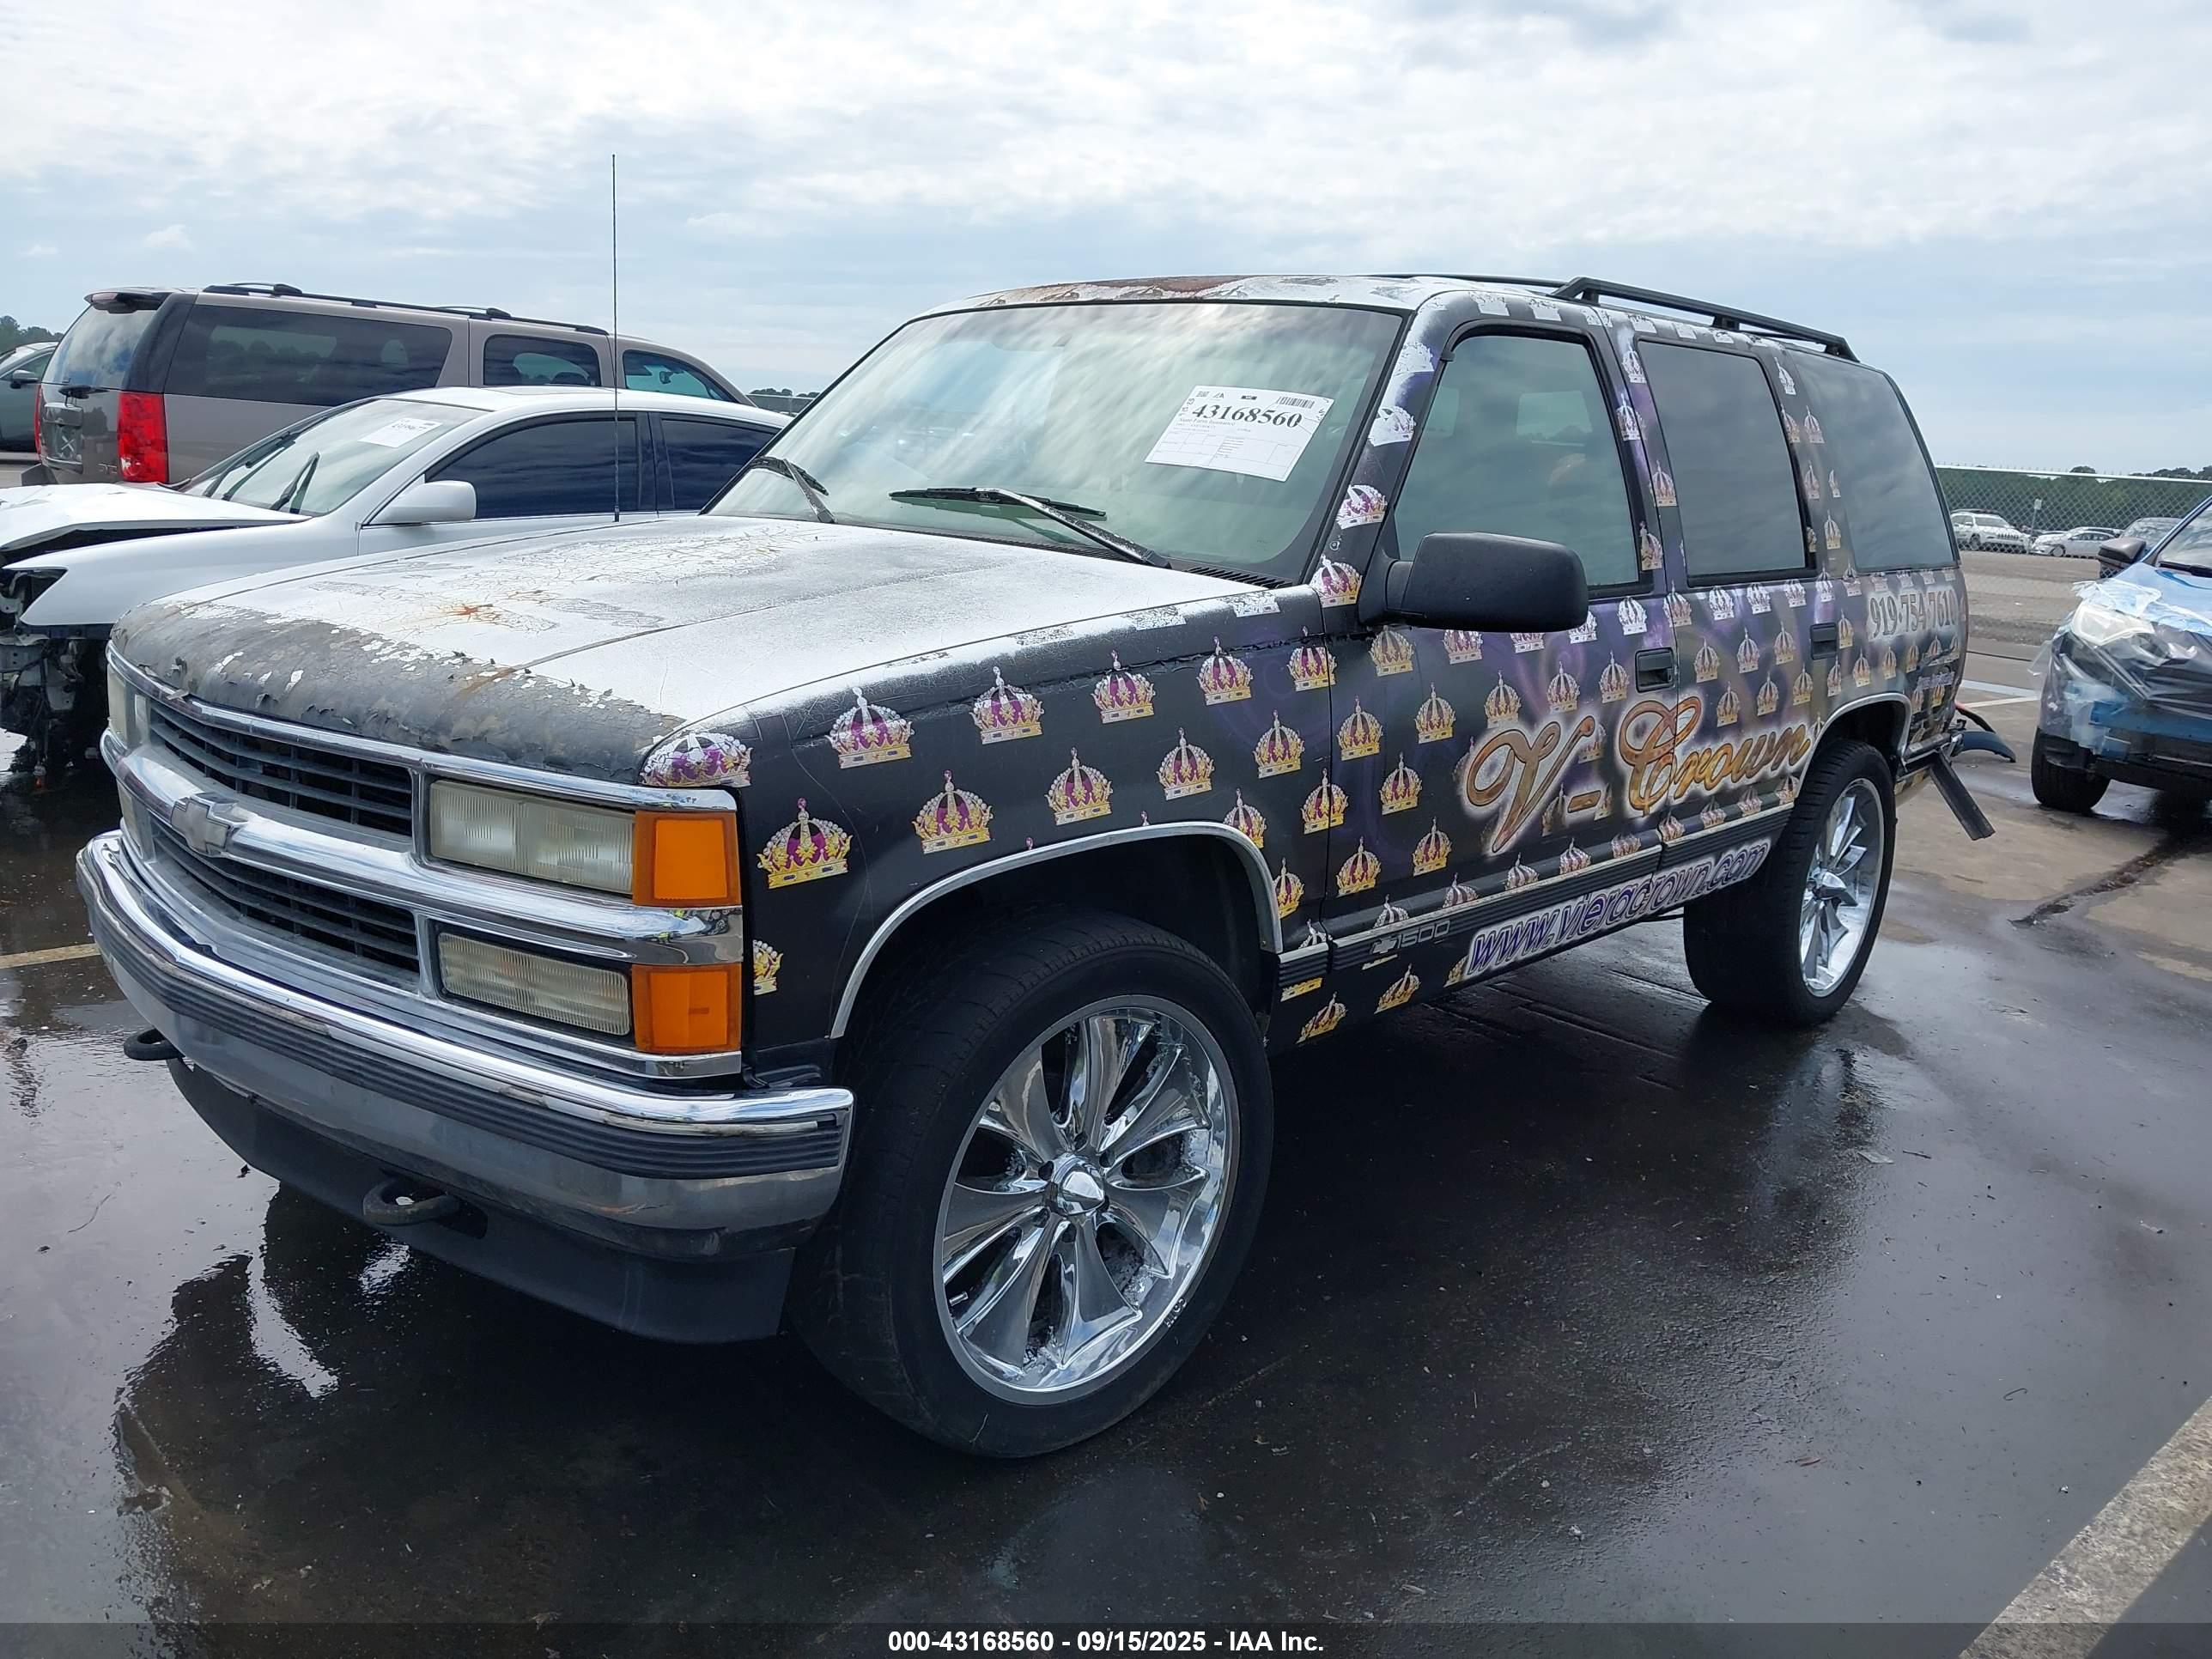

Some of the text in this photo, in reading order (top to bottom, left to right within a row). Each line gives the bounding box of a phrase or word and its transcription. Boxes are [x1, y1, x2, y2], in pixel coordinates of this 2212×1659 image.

[1192, 404, 1303, 429] 43168560
[1620, 696, 1810, 817] Crown
[1396, 920, 1450, 949] 1500
